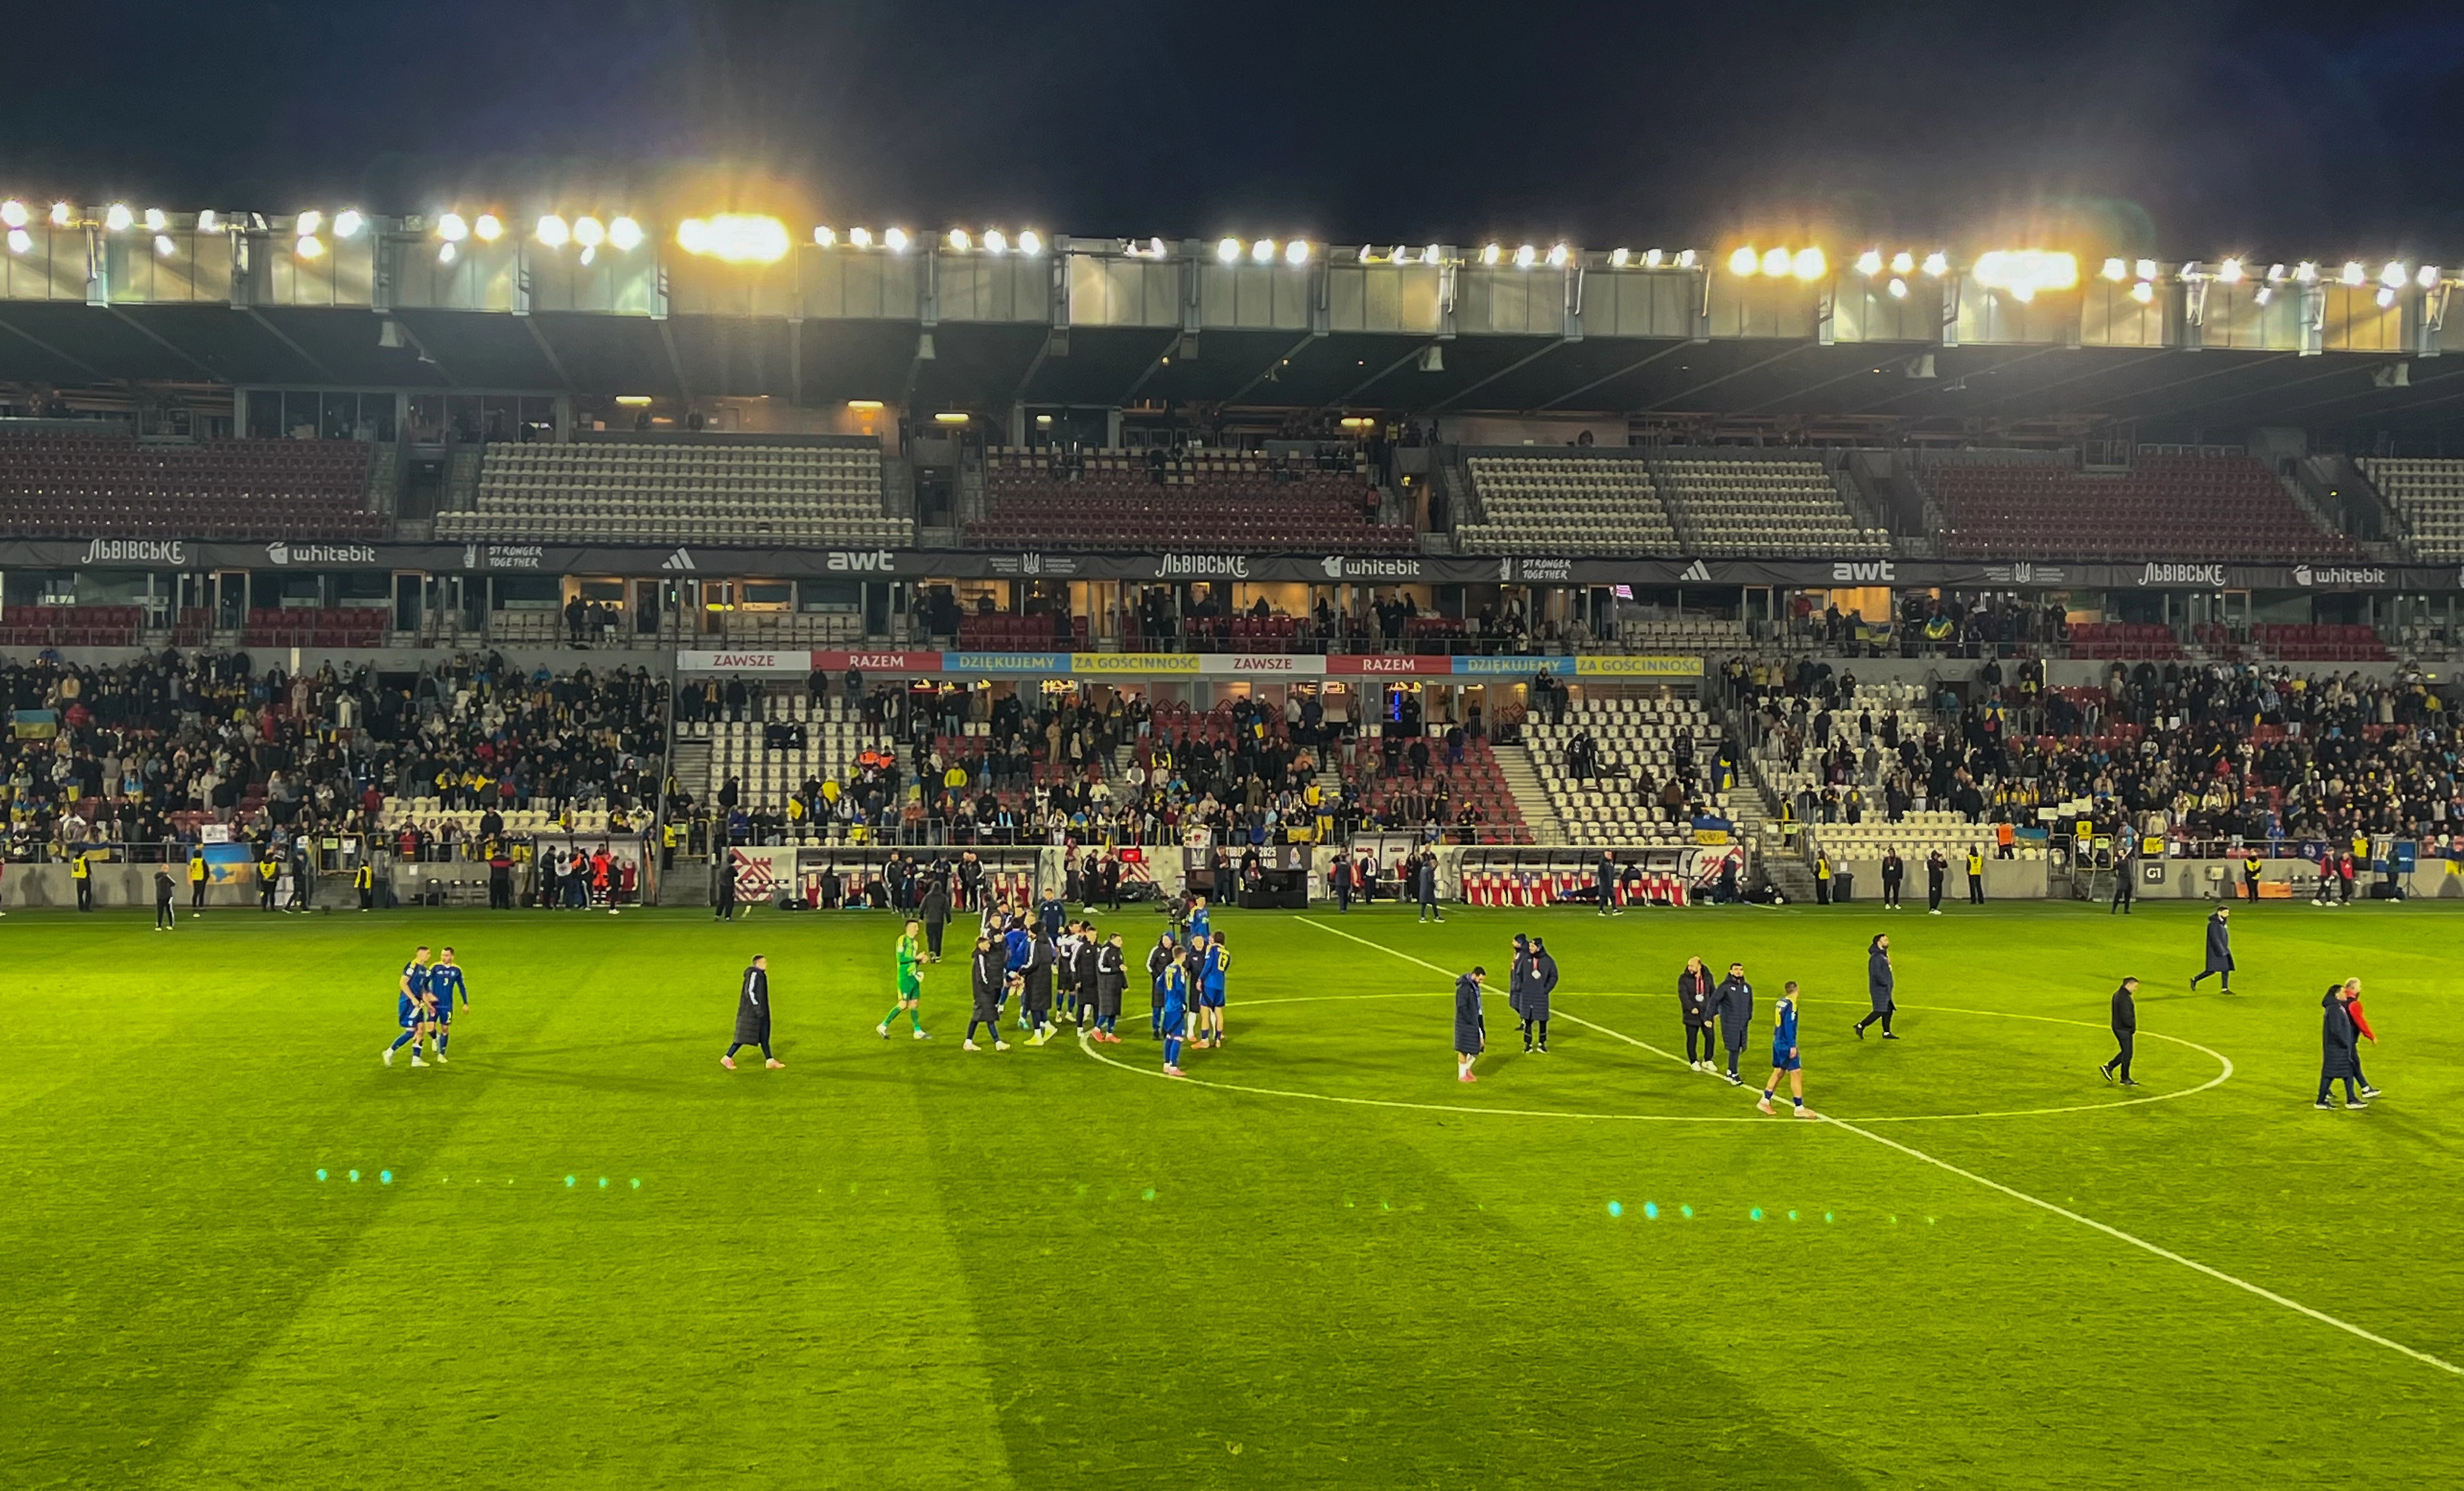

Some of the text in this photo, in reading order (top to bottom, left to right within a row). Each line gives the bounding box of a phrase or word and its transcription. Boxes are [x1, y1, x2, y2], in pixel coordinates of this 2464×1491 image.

[294, 545, 375, 562] whitebit
[489, 546, 543, 557] STRONGER
[489, 557, 538, 568] TOGETHER
[827, 550, 895, 571] awt
[1523, 559, 1571, 569] STRONGER
[1346, 559, 1420, 575] whitebit
[1833, 560, 1895, 581] awt
[1523, 569, 1568, 580] TOGETHER
[2316, 567, 2386, 583] whitebit
[713, 655, 775, 667] ZAWSZE
[849, 655, 904, 667] RAZEM
[959, 656, 1056, 671] DZIĘKUJEMY
[1074, 657, 1093, 669] ZA
[1233, 658, 1292, 670] ZAWSZE
[1362, 659, 1415, 671] RAZEM
[1468, 659, 1560, 674] DZIĘKUJEMY
[1579, 660, 1597, 671] ZA
[2146, 868, 2162, 878] G1
